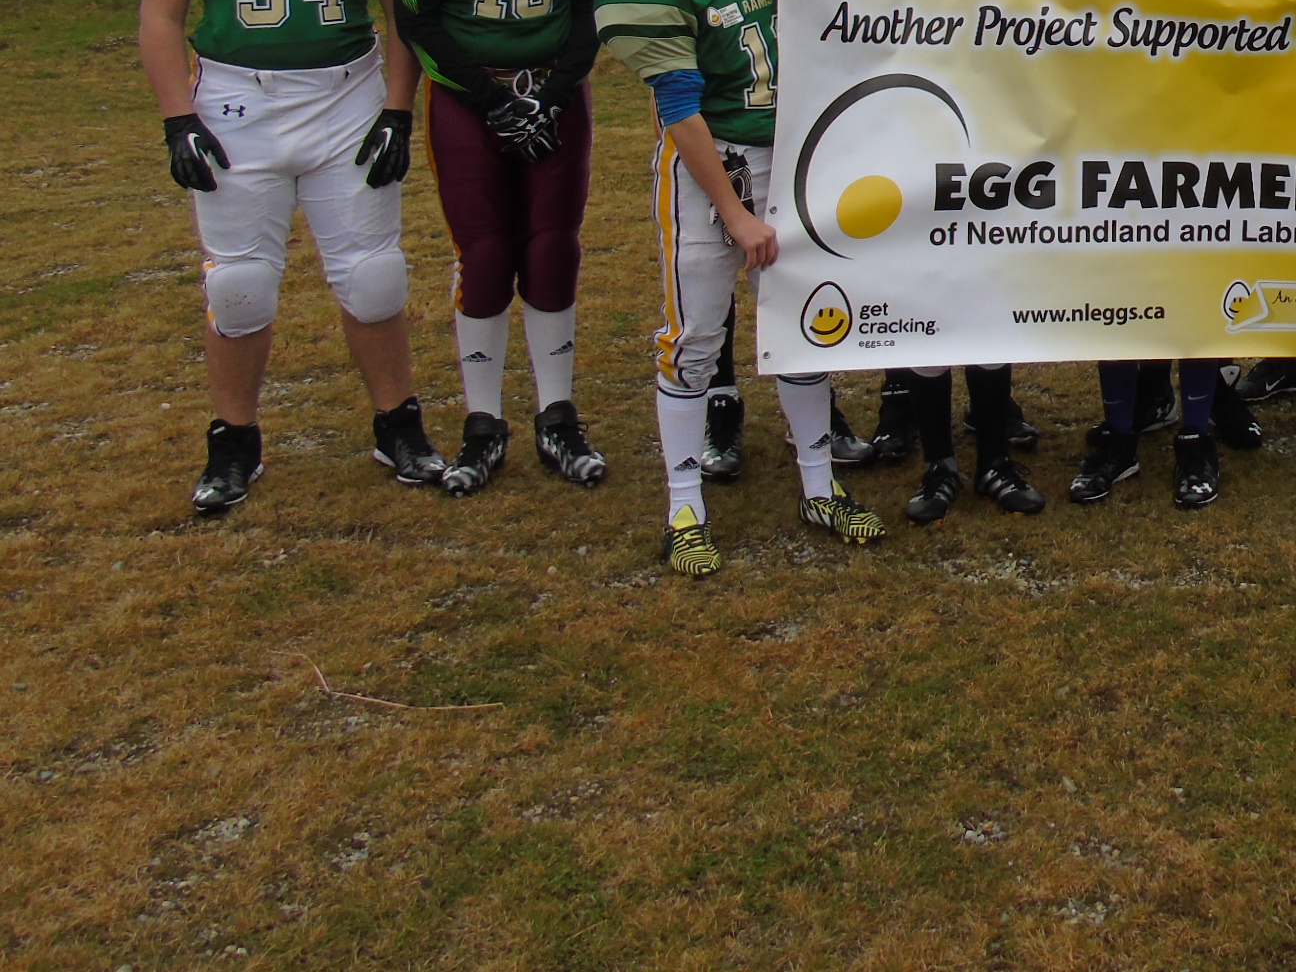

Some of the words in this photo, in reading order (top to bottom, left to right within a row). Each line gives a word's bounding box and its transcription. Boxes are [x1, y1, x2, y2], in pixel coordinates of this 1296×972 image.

[819, 1, 965, 45] Another
[973, 5, 1098, 56] Project
[1106, 7, 1292, 57] Supported
[934, 160, 1056, 212] EGG
[929, 221, 958, 246] of
[967, 219, 1170, 246] Newfoundland
[1179, 218, 1231, 243] and
[1271, 290, 1293, 305] An
[859, 302, 889, 320] get
[1012, 302, 1166, 326] www.nleggs.ca
[858, 338, 896, 349] eggs.ca
